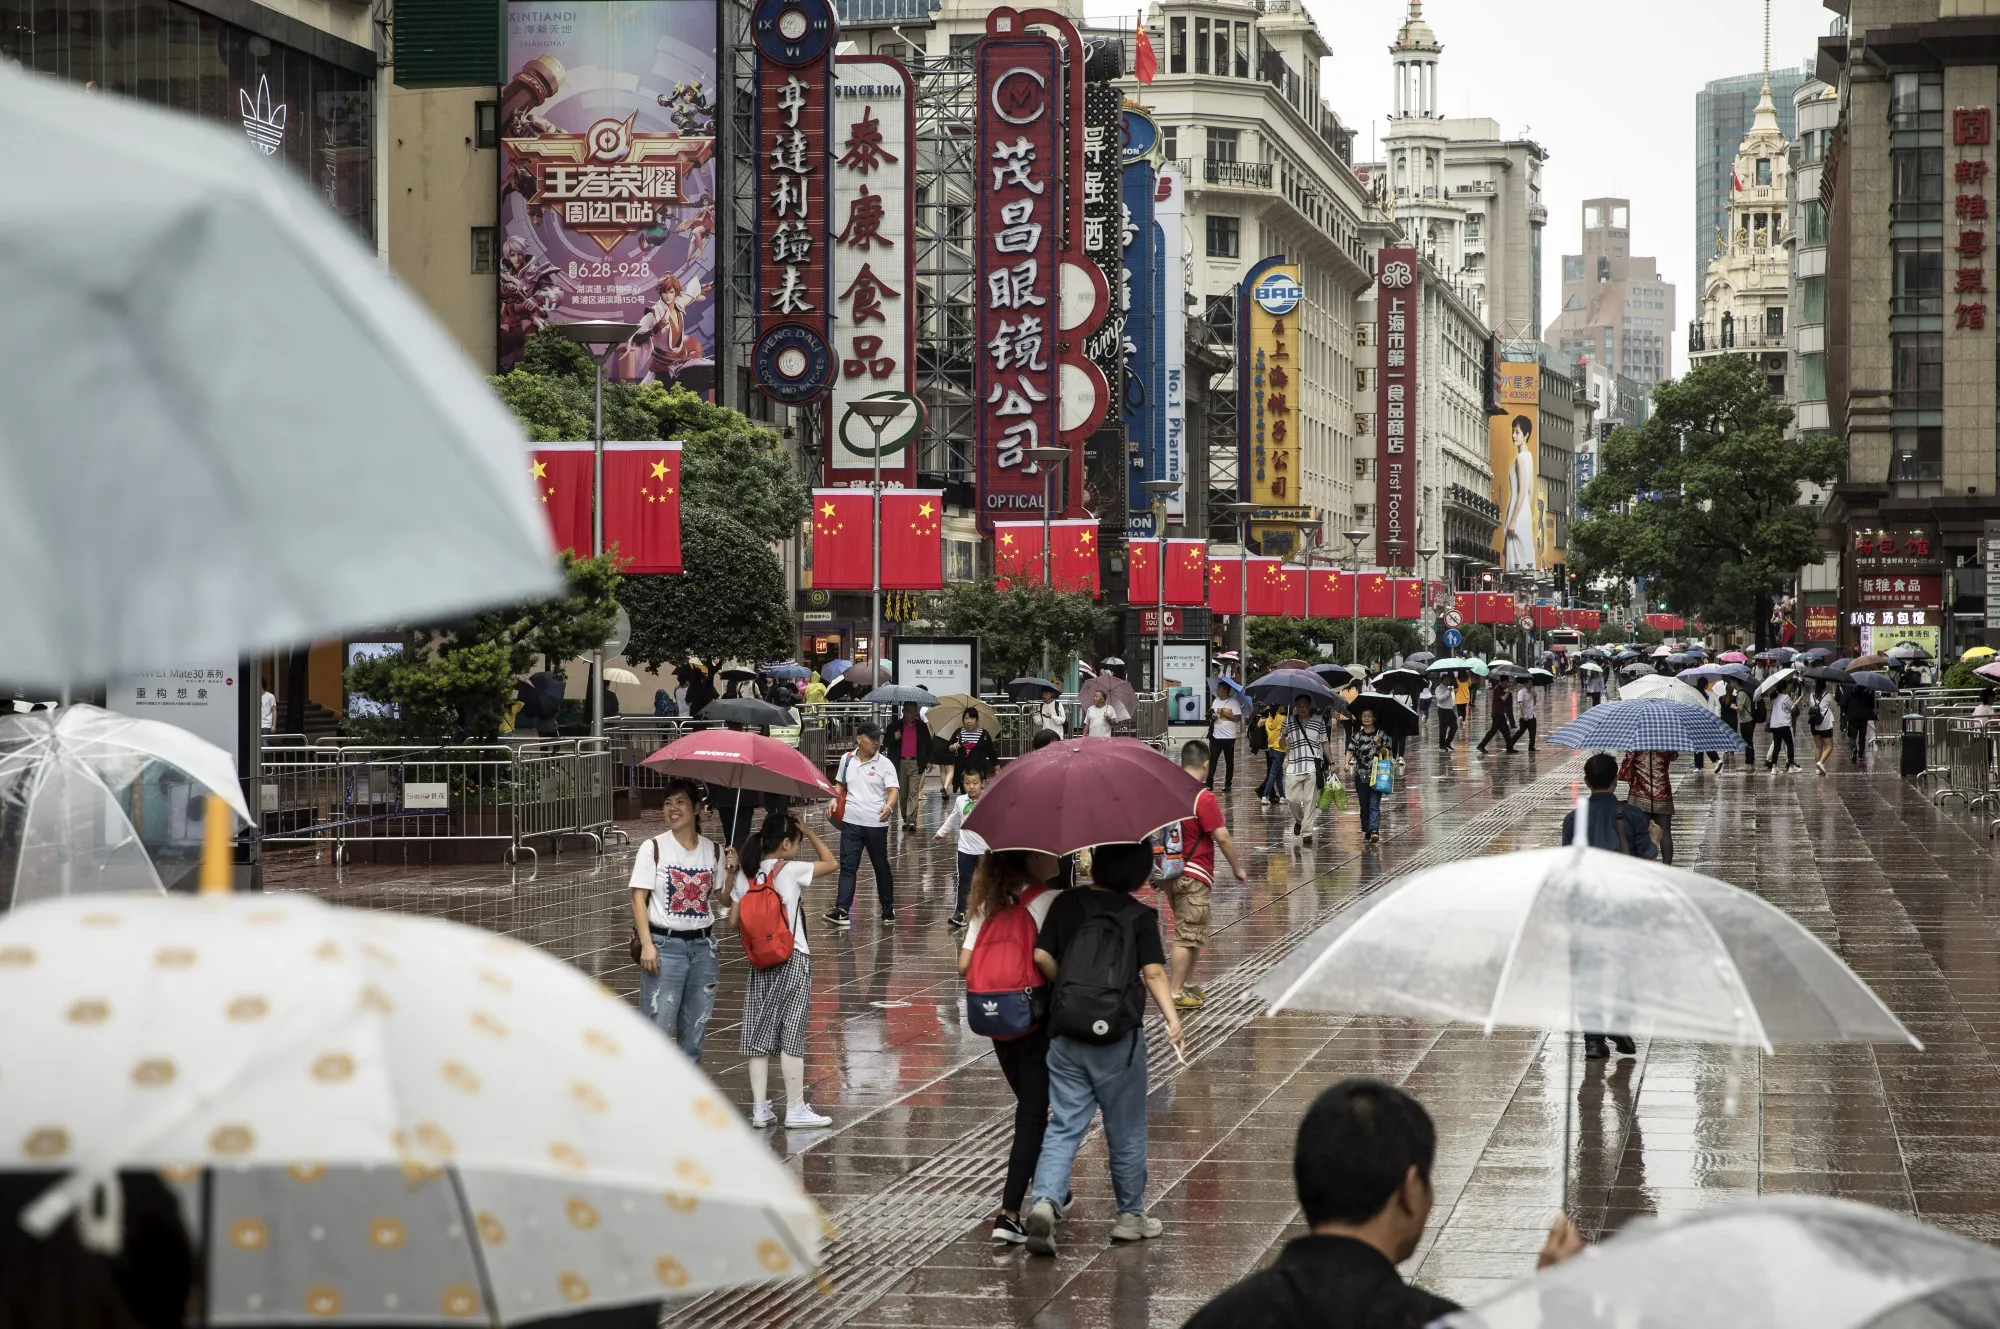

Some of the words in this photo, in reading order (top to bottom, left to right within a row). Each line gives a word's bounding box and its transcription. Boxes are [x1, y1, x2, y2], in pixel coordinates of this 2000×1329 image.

[508, 12, 576, 21] XINTIANDI
[511, 24, 572, 34] 上海新天地
[541, 165, 679, 198] 王者荣耀
[565, 201, 653, 223] 周边Q站
[836, 105, 902, 380] 泰康食品
[988, 136, 1047, 474] 茂昌眼镜公司
[762, 329, 790, 353] HENG
[1388, 297, 1405, 454] 上海市第一食品商店
[1169, 369, 1181, 408] No.1
[1389, 463, 1401, 490] First
[987, 493, 1045, 509] OPTICAL
[1863, 578, 1921, 592] 新雅食品
[1882, 611, 1925, 625] 汤包馆
[1900, 630, 1930, 638] 蟹黄汤包
[169, 669, 204, 679] Mate30
[206, 669, 224, 679] 系列
[135, 687, 209, 699] 重构想象
[431, 792, 446, 800] 世茂
